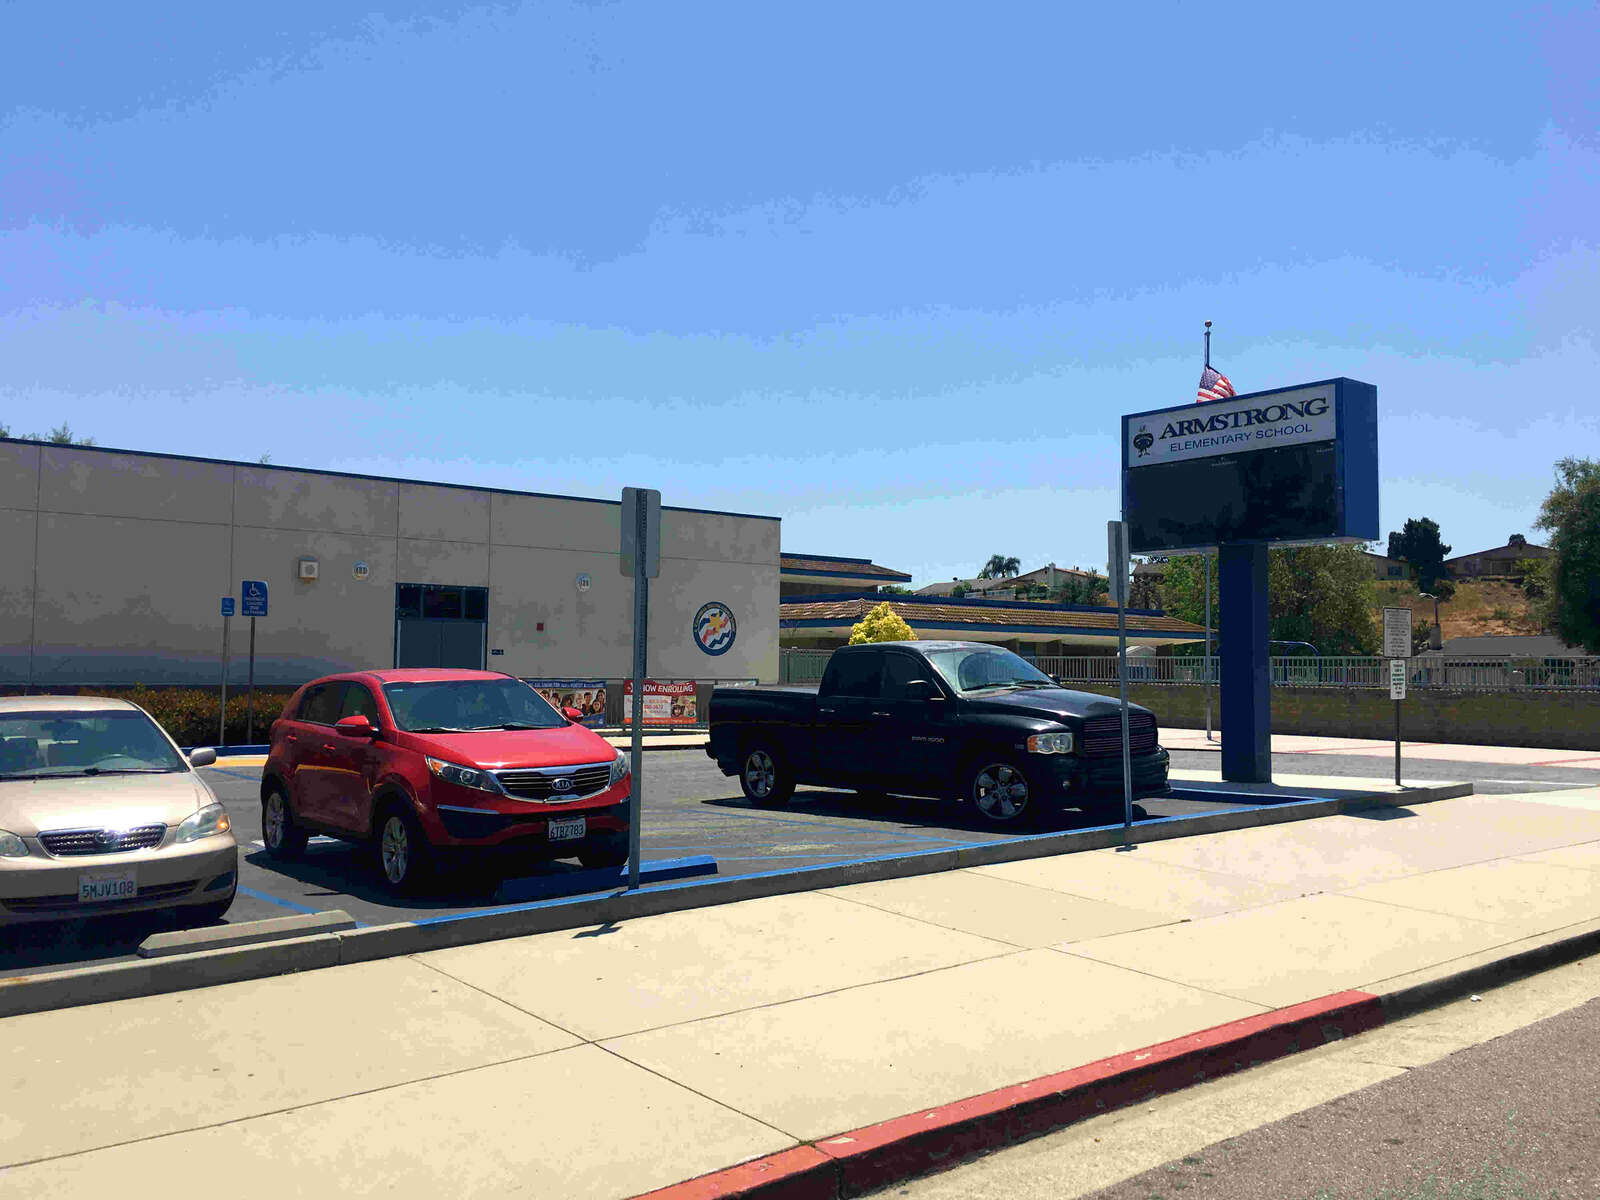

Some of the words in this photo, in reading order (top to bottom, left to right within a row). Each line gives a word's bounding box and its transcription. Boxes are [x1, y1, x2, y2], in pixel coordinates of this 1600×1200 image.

[1158, 397, 1330, 441] ARMSTRONG
[1170, 431, 1253, 452] ELEMENTARY
[1255, 423, 1313, 439] SCHOOL
[657, 684, 693, 693] ENROLLING
[555, 781, 570, 789] KIA
[82, 880, 134, 898] 5MJV108
